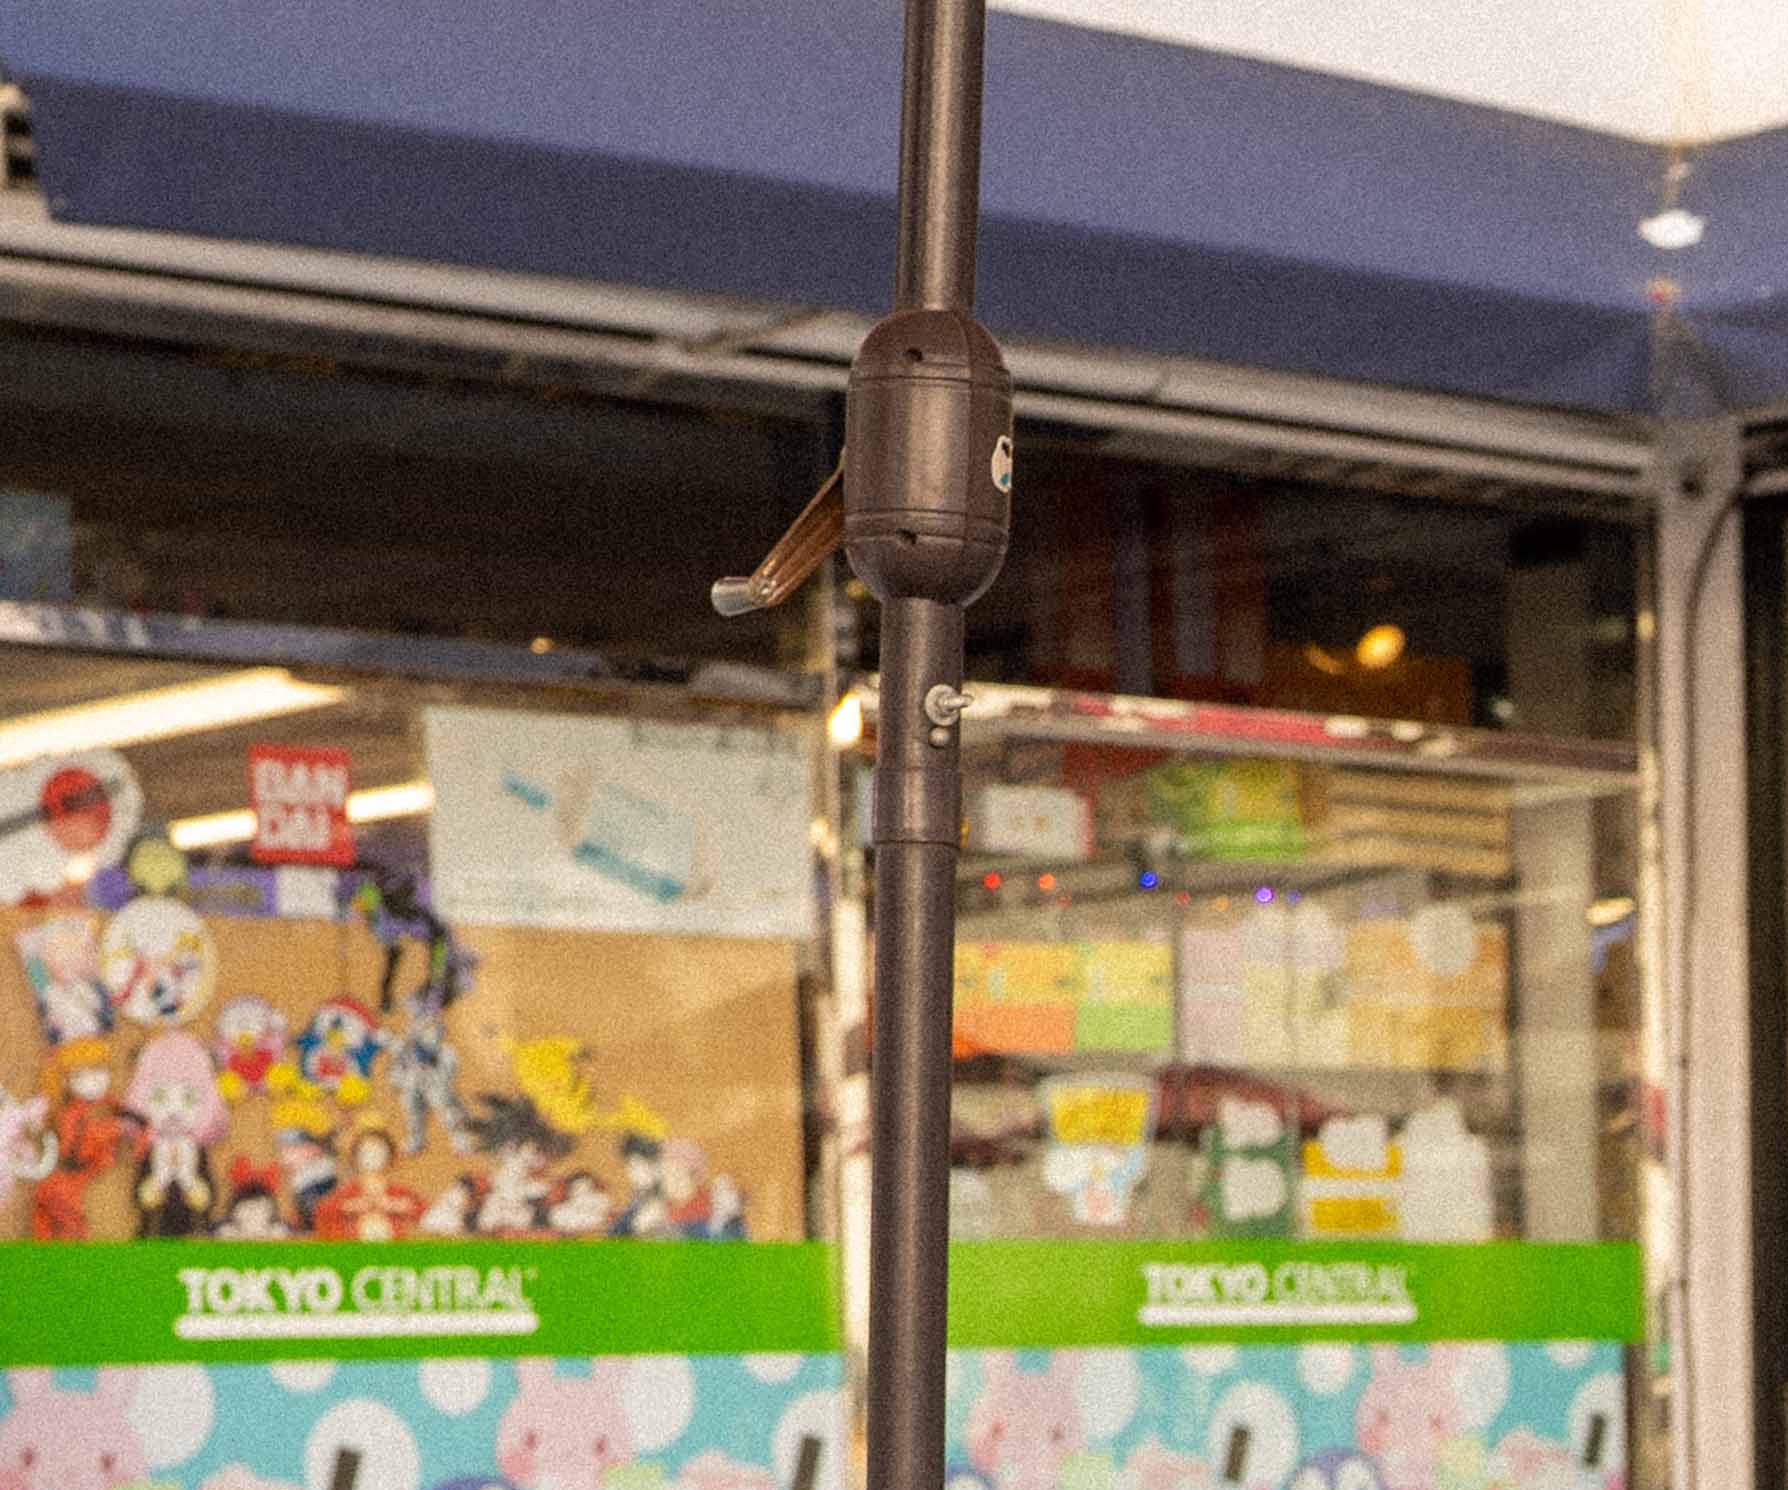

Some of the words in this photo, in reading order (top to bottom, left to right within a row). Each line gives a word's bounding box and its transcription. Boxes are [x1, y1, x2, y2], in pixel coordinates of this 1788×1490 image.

[178, 1266, 343, 1313] TOKYO
[351, 1265, 534, 1312] CENTRAL
[1142, 1262, 1268, 1305] TOKYO
